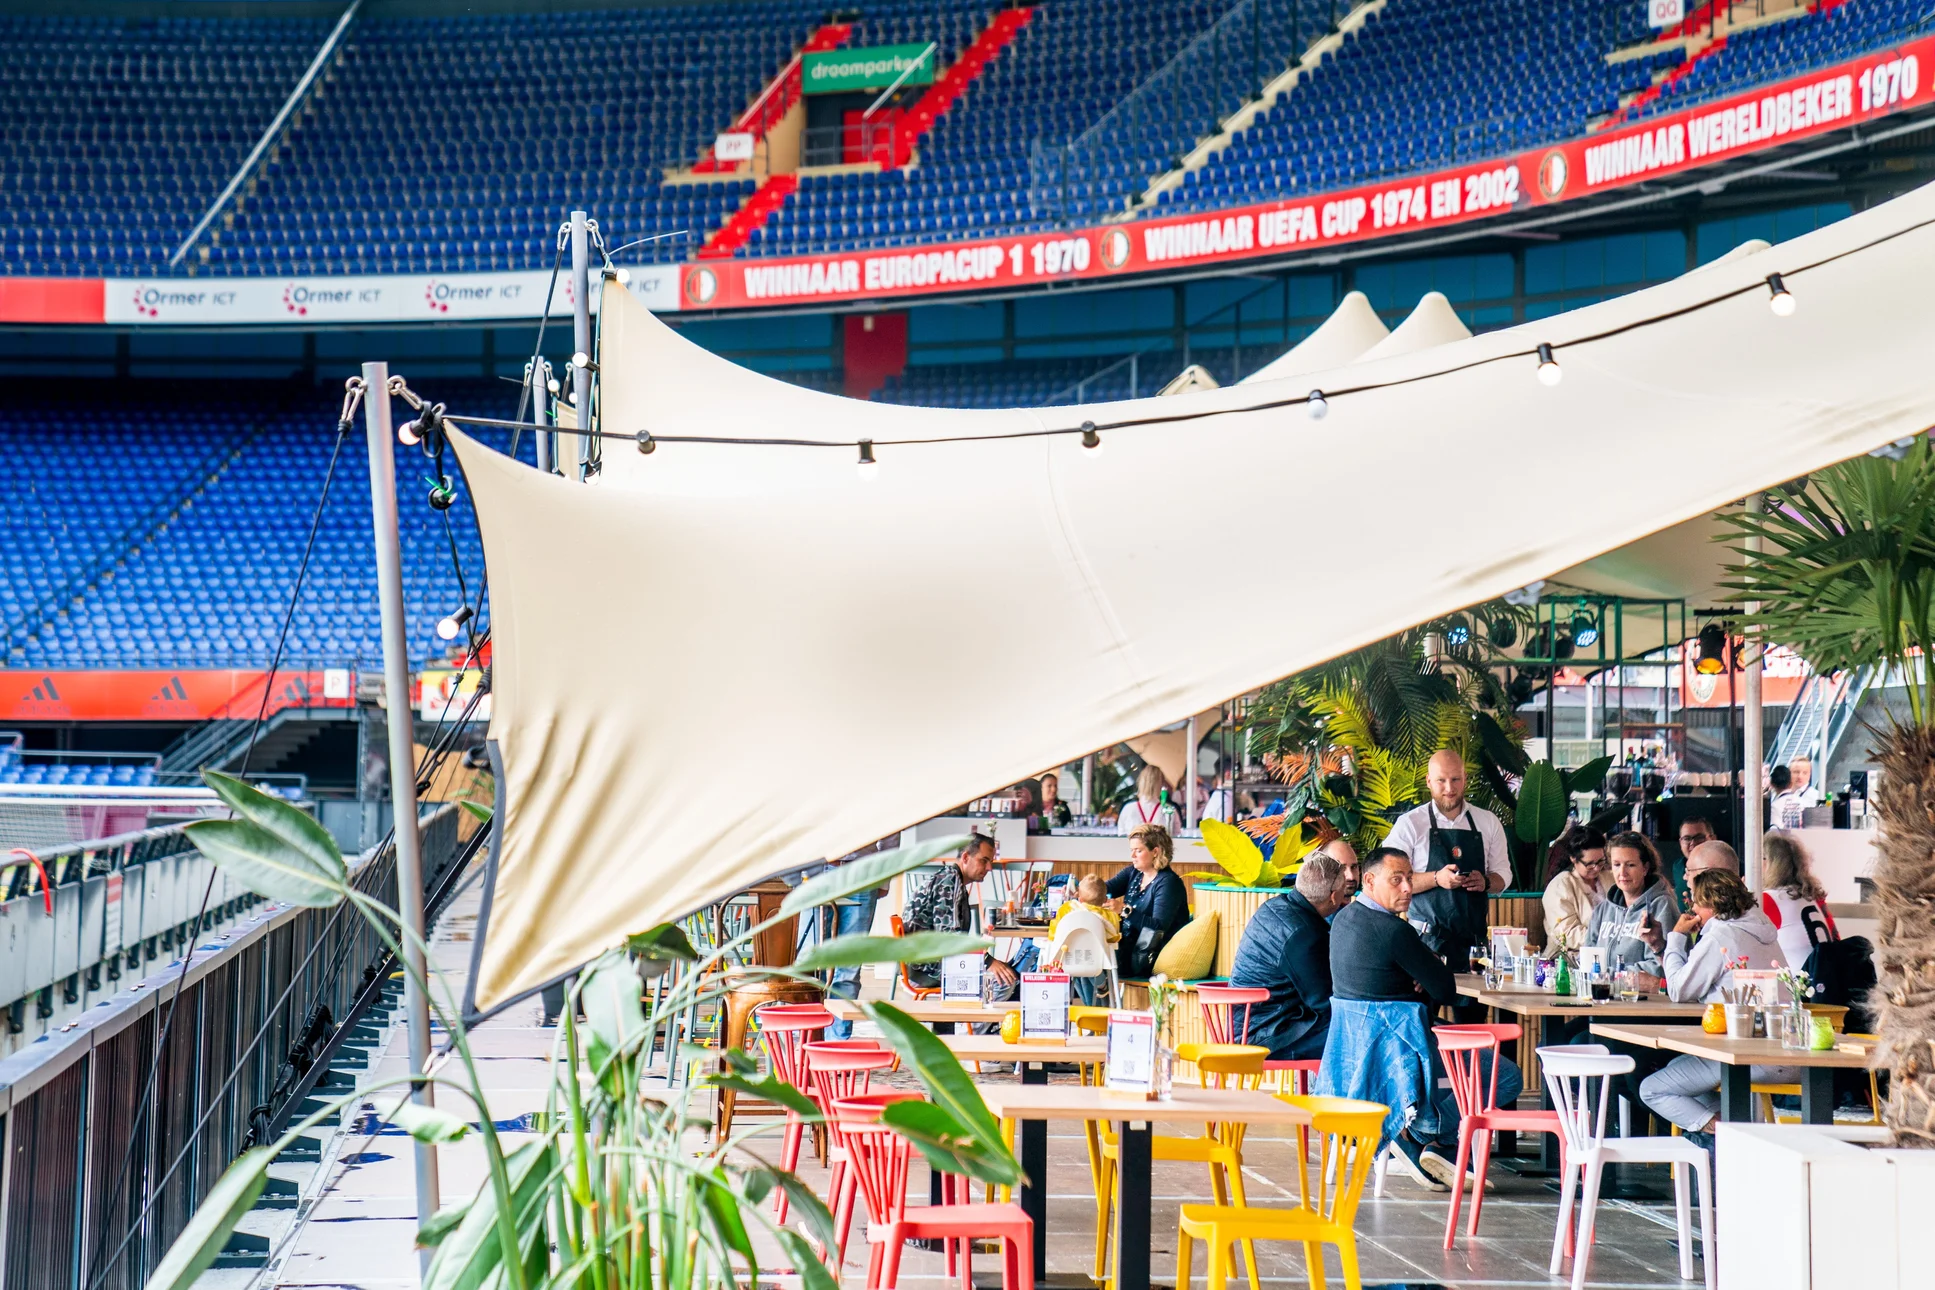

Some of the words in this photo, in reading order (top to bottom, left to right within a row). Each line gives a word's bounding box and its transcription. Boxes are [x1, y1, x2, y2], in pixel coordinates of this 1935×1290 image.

[1585, 123, 1685, 186] WINNAAR
[1687, 74, 1853, 159] WERELDBEKER
[1858, 54, 1919, 112] 1970
[1144, 215, 1254, 262] WINNAAR
[1258, 205, 1318, 247] UEFA
[1322, 197, 1366, 238] CUP
[1370, 186, 1427, 229] 1974
[1431, 178, 1461, 219] EN
[1464, 165, 1520, 213] 2002
[743, 260, 859, 299] WINNAAR
[864, 245, 1004, 290] EUROPACUP
[1009, 243, 1024, 277] 1
[1030, 237, 1091, 275] 1970
[144, 288, 206, 306] Ormer
[294, 287, 352, 303] Ormer
[435, 283, 493, 300] Ormer
[959, 960, 966, 970] 6
[1041, 989, 1049, 1000] 5
[1127, 1033, 1134, 1045] 4
